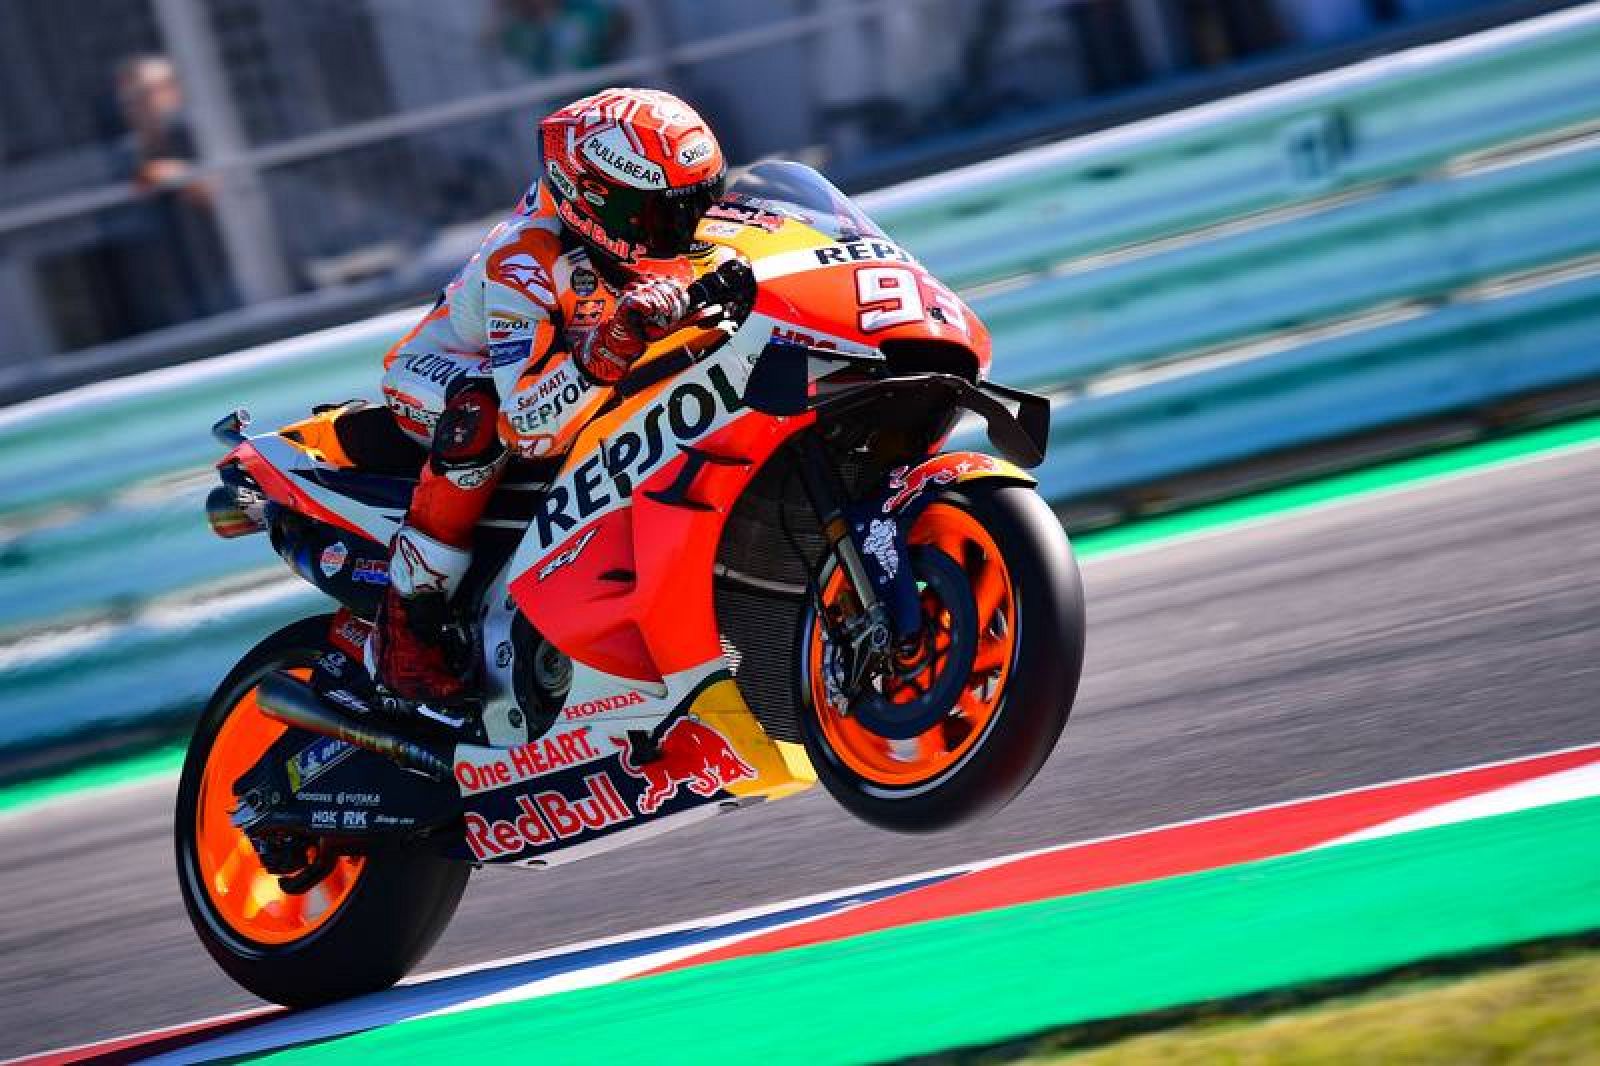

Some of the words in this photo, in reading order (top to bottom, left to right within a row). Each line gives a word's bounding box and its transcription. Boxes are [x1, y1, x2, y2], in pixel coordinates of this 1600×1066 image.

[588, 136, 662, 185] PULL&BEAR
[511, 374, 592, 433] REPSOL
[537, 362, 748, 549] REPSOL
[564, 690, 646, 722] HONDA
[454, 760, 513, 791] One
[508, 727, 600, 779] HEART.
[343, 811, 368, 824] RK
[464, 794, 555, 861] Red
[537, 771, 634, 839] Bull
